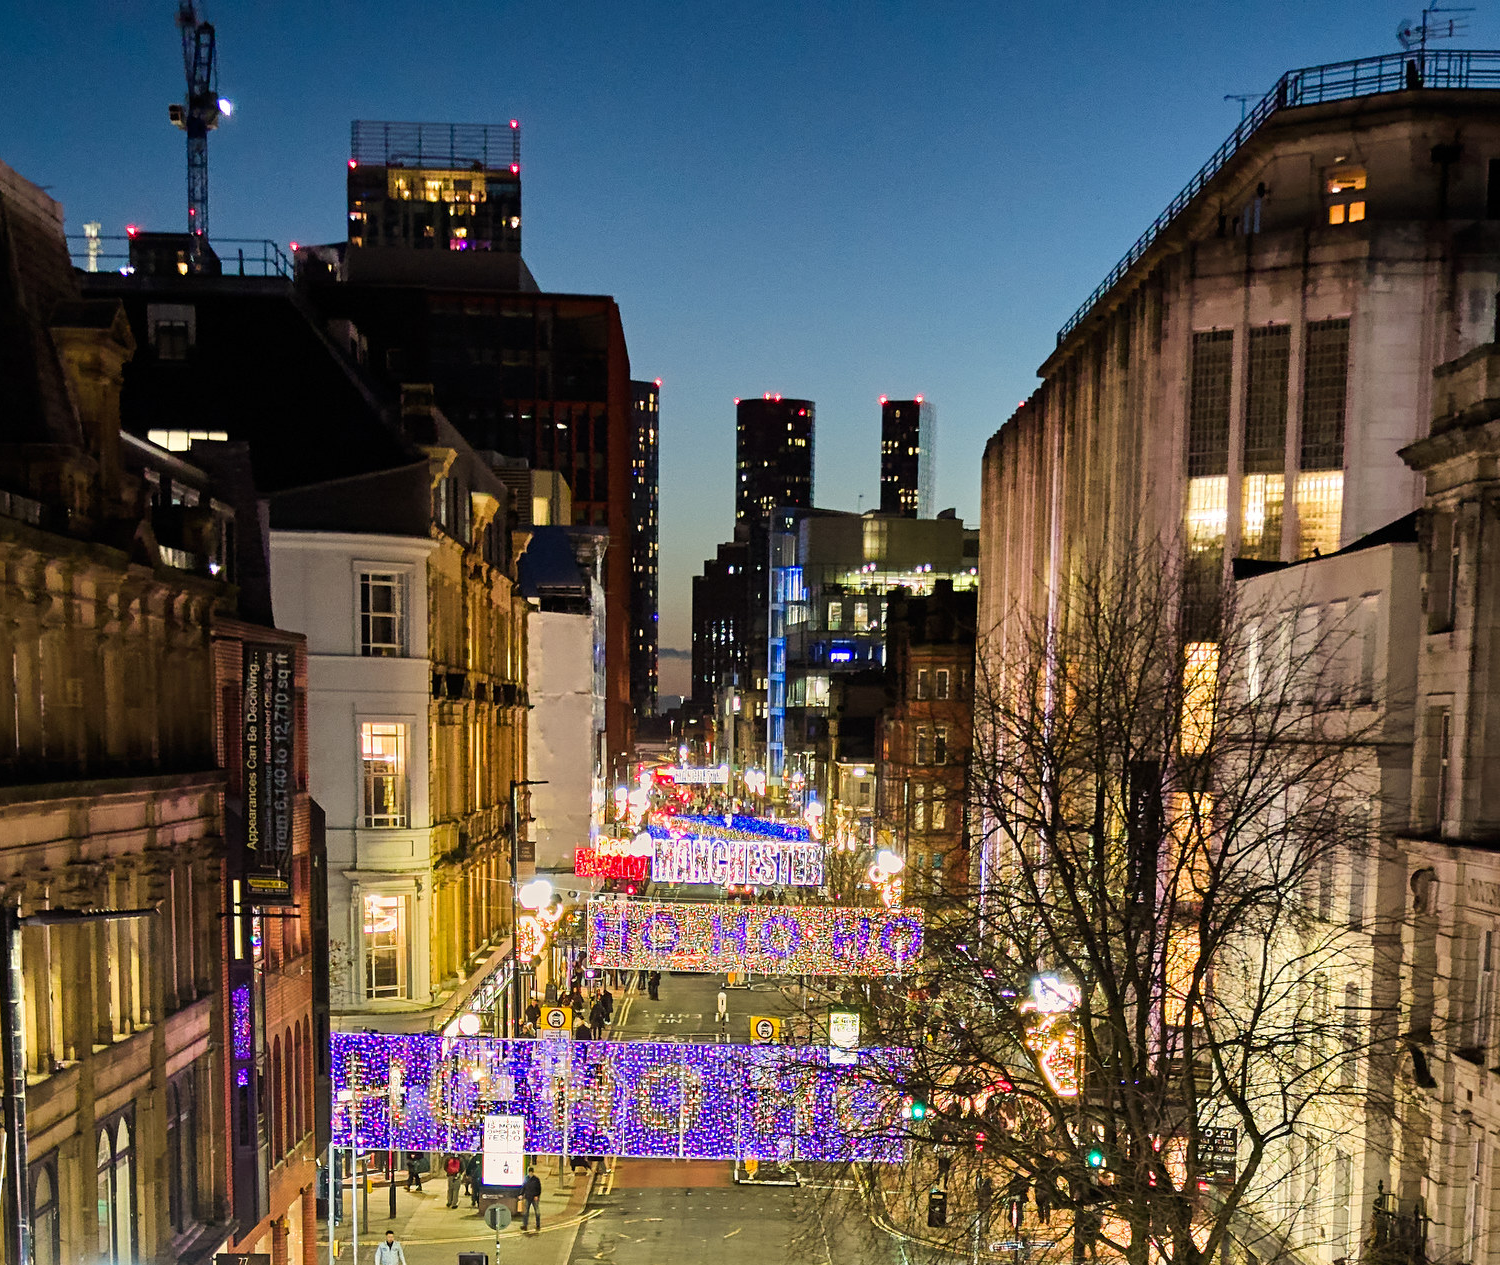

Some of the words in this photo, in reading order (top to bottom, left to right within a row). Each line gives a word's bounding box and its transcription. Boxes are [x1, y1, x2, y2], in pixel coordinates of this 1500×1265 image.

[264, 652, 272, 680] Suites
[275, 653, 288, 665] ft
[248, 651, 259, 722] Deceiving...
[277, 669, 291, 689] sq
[247, 725, 257, 742] Be
[274, 693, 291, 743] 12,710
[247, 745, 257, 769] Can
[275, 748, 287, 763] to
[274, 769, 290, 810] 6,140
[247, 772, 258, 850] Appearances
[275, 815, 288, 851] from
[653, 839, 825, 886] MANCHESTER
[710, 914, 801, 958] HO
[830, 915, 924, 963] HO
[238, 1257, 250, 1265] 77
